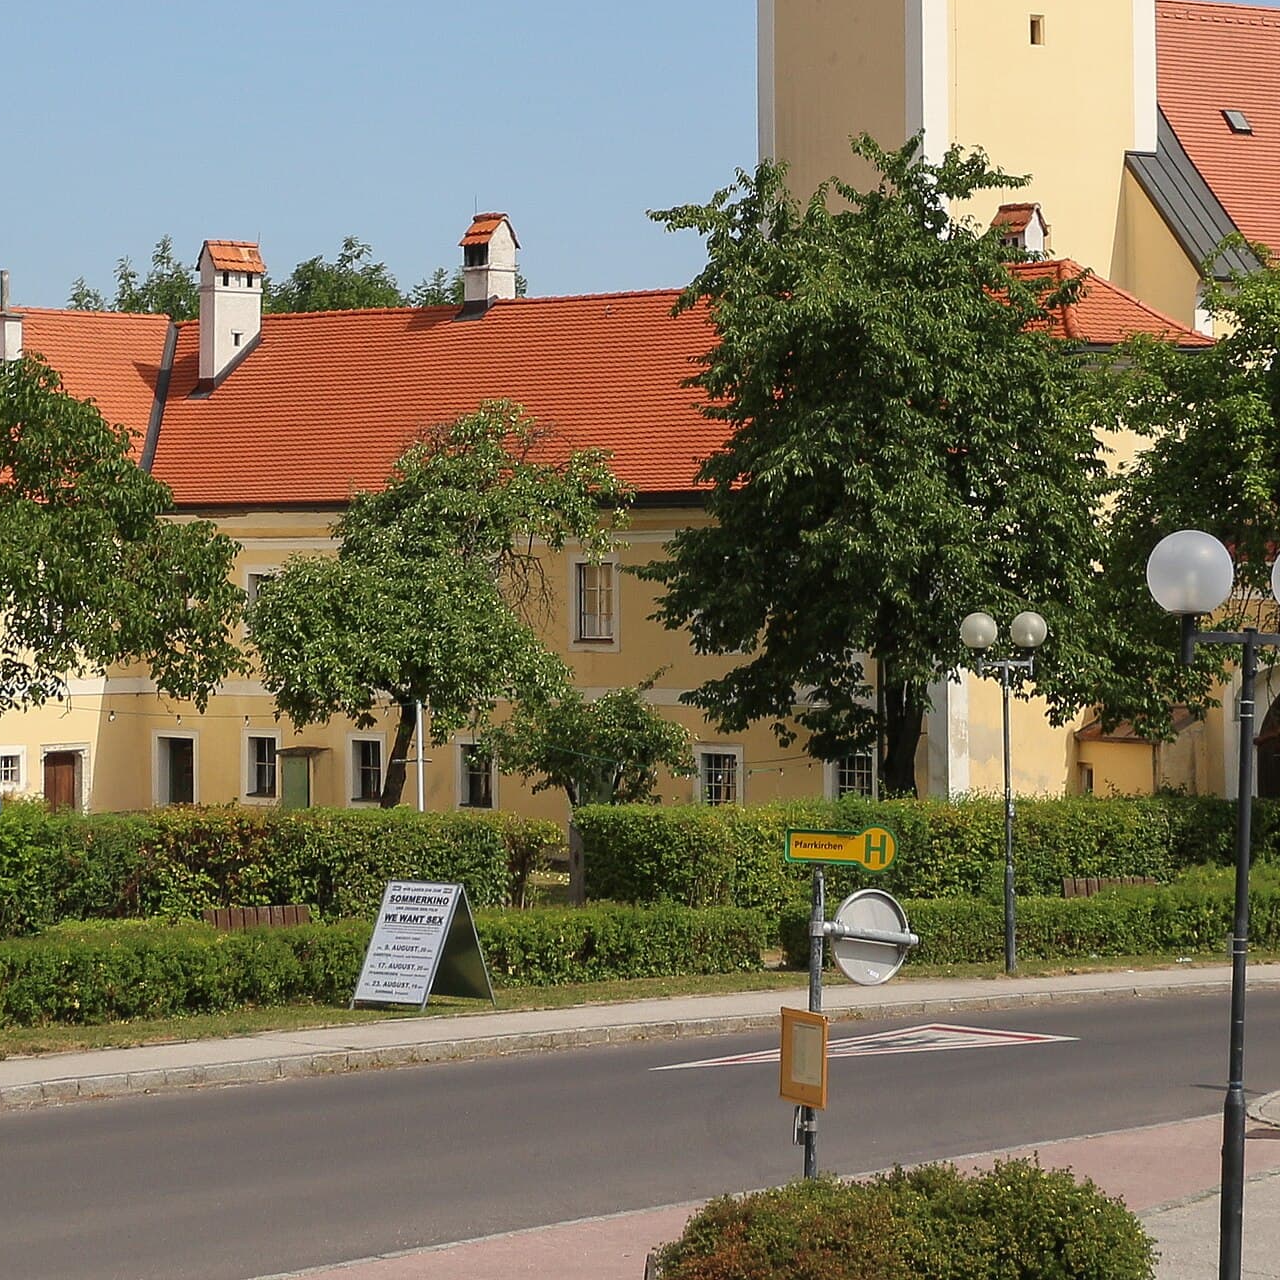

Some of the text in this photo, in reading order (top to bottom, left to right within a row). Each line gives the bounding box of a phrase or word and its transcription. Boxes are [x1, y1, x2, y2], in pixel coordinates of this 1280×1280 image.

[794, 834, 887, 864] Pfarrkirchen H
[389, 894, 450, 905] SOMMERKINO
[384, 913, 444, 925] WE WANT SEX
